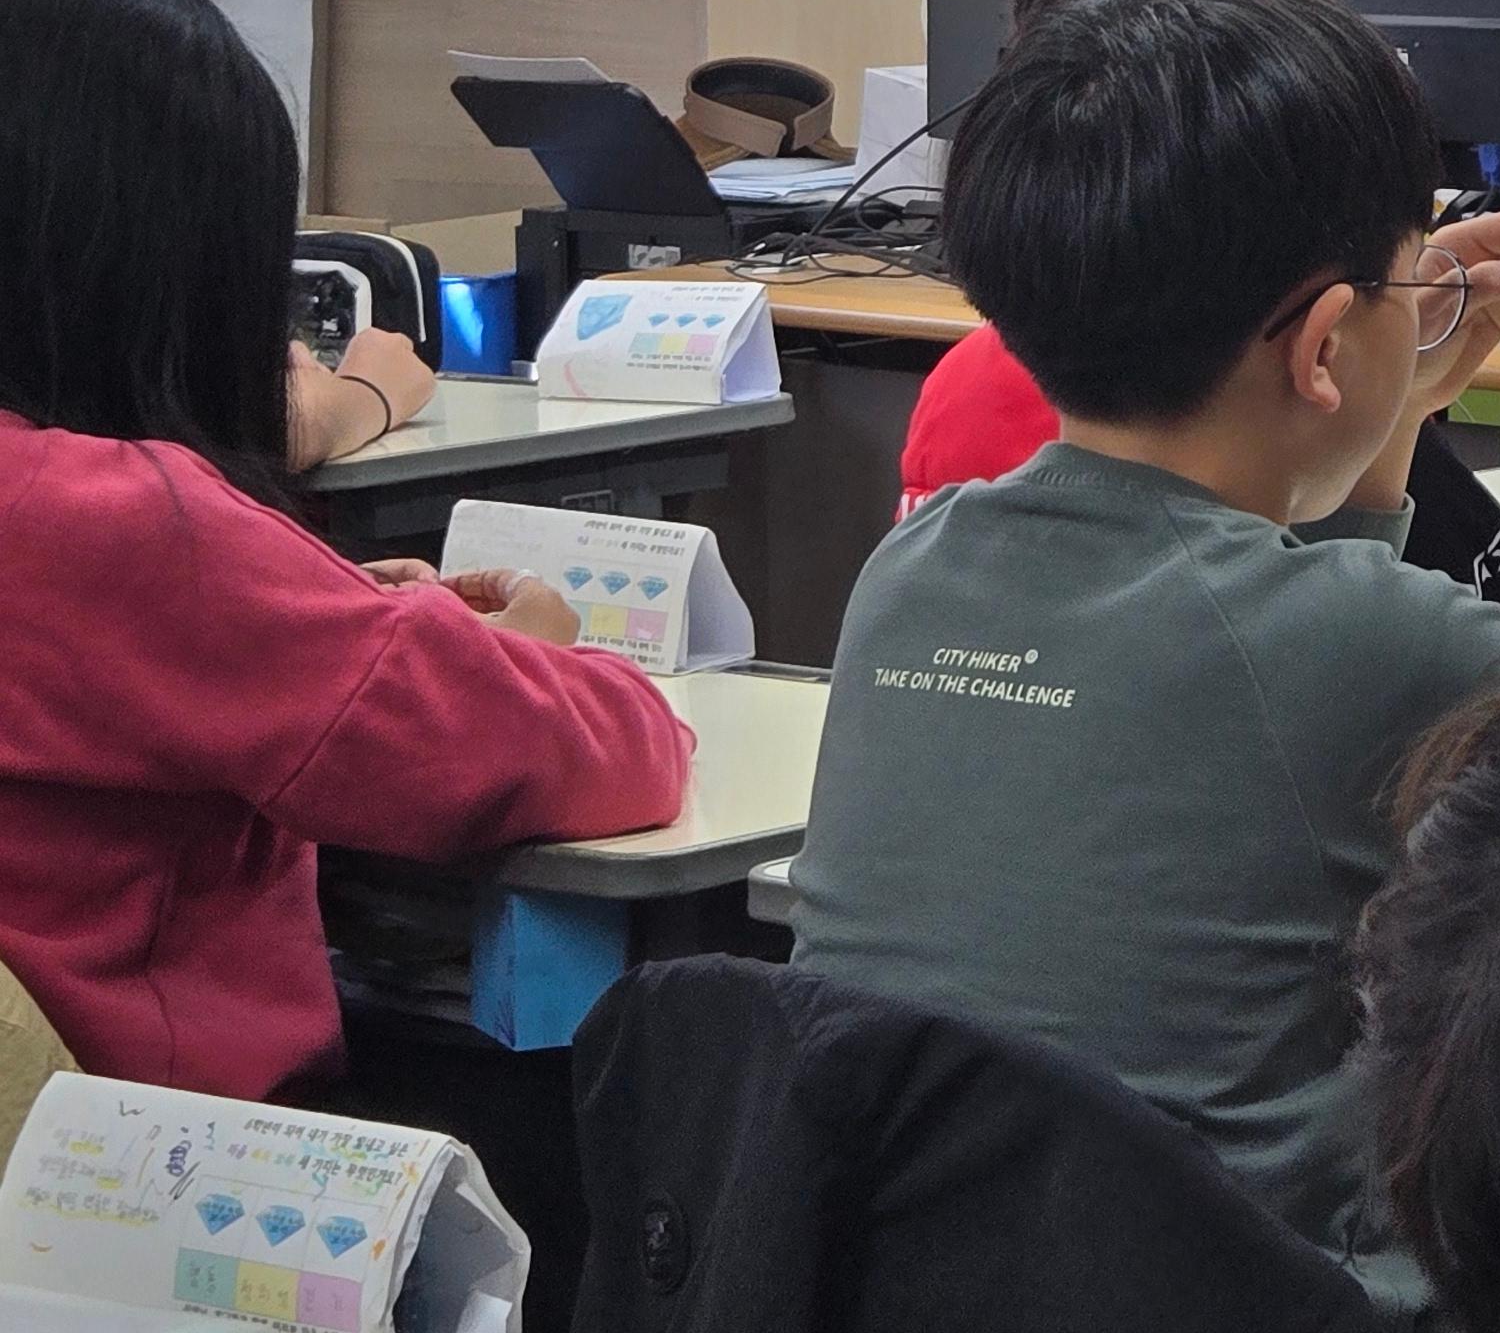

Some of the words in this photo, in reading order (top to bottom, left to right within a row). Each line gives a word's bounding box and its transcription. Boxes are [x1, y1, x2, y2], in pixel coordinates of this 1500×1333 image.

[933, 648, 968, 667] CITY
[874, 668, 907, 689] TAKE
[909, 671, 937, 691] ON
[935, 674, 970, 696] THE
[970, 678, 1076, 709] CHALLENGE
